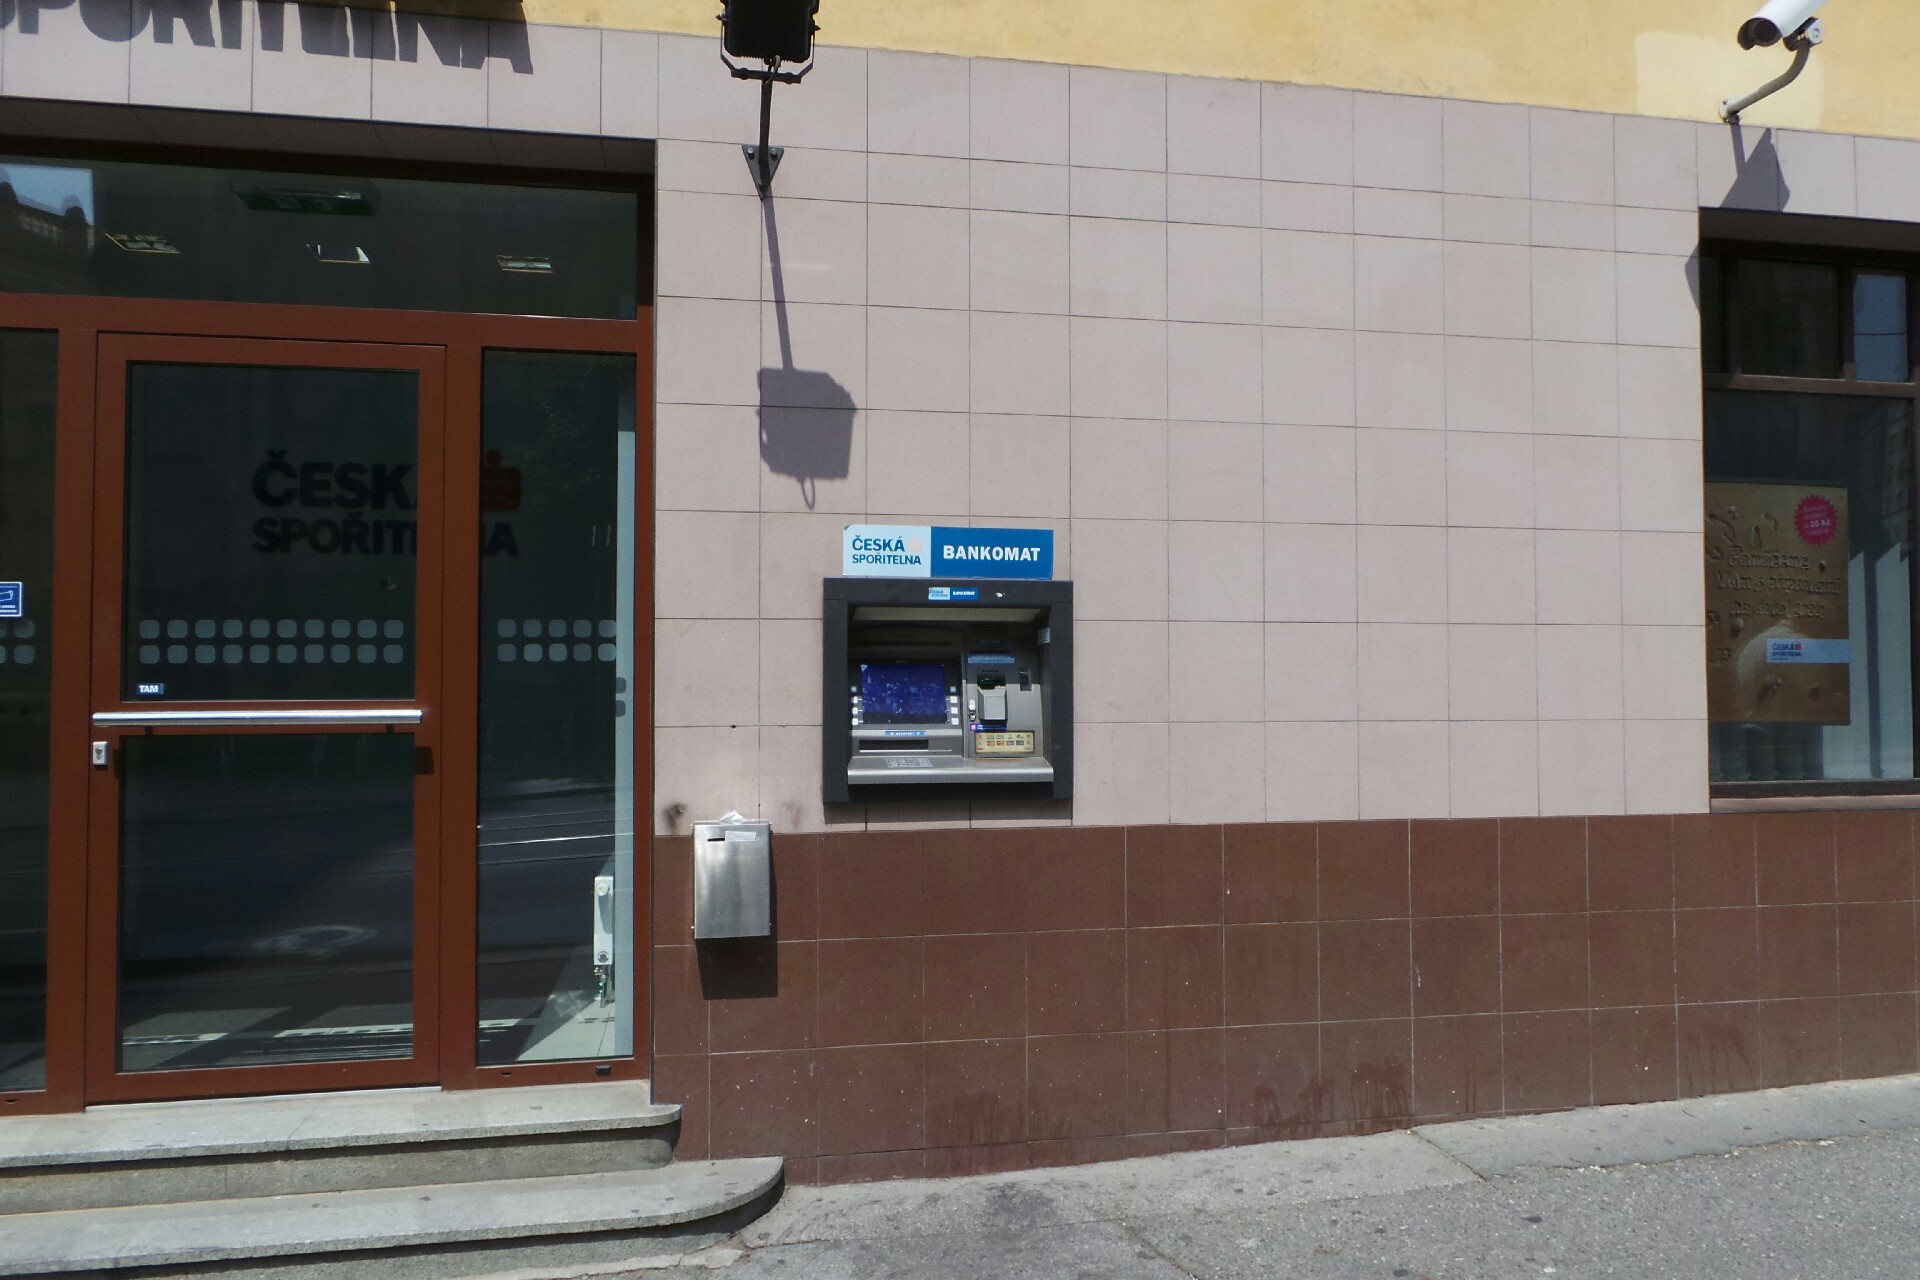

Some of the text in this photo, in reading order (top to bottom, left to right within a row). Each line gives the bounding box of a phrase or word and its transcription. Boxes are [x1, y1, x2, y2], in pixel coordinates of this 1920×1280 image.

[253, 449, 417, 509] ČESK
[252, 511, 519, 556] SPOŘITA
[852, 535, 905, 552] ČESKÁ
[852, 553, 921, 565] SPOŘITELNA
[943, 545, 1040, 561] BANKOMAT
[138, 684, 159, 693] TAM
